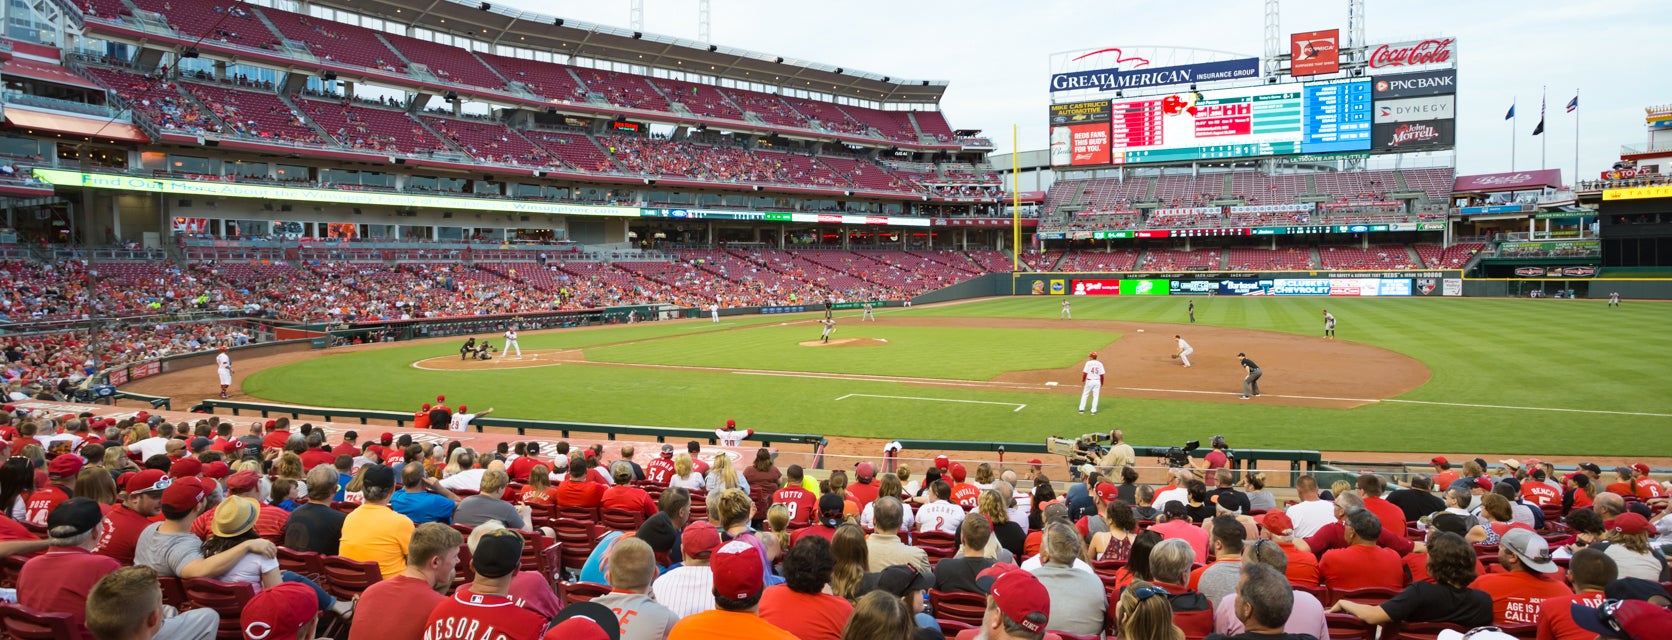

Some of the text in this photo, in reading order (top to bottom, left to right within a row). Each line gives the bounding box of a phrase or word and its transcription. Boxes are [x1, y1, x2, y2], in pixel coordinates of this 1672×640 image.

[1369, 39, 1455, 68] Coca-Cola
[1196, 70, 1232, 80] INSURANCE
[1233, 68, 1255, 77] GROUP
[1390, 75, 1454, 90] PNC BANK
[1058, 107, 1101, 115] AUTOMOTIVE
[1070, 101, 1109, 109] CASTRUCCI
[1396, 103, 1447, 114] DYNEGY
[1406, 124, 1426, 132] John
[1388, 127, 1439, 146] Morrell
[82, 174, 121, 186] Find
[128, 178, 163, 190] Out
[171, 182, 217, 193] More
[221, 185, 269, 196] About
[275, 188, 297, 198] the
[1274, 286, 1330, 295] CHEVROLET
[1090, 367, 1099, 375] 45
[649, 460, 674, 473] CHAPMAN
[648, 467, 665, 483] 54
[522, 489, 551, 501] MESOACO
[780, 490, 803, 499] VOTTO
[955, 489, 976, 499] DUVALL
[1531, 487, 1555, 498] BENCH
[1649, 485, 1659, 498] 6
[29, 500, 52, 509] ROSE
[927, 506, 955, 516] COZART
[935, 516, 944, 531] 2
[1506, 601, 1534, 613] AGE IS
[1504, 610, 1532, 622] CALL
[1022, 619, 1040, 632] CINCY
